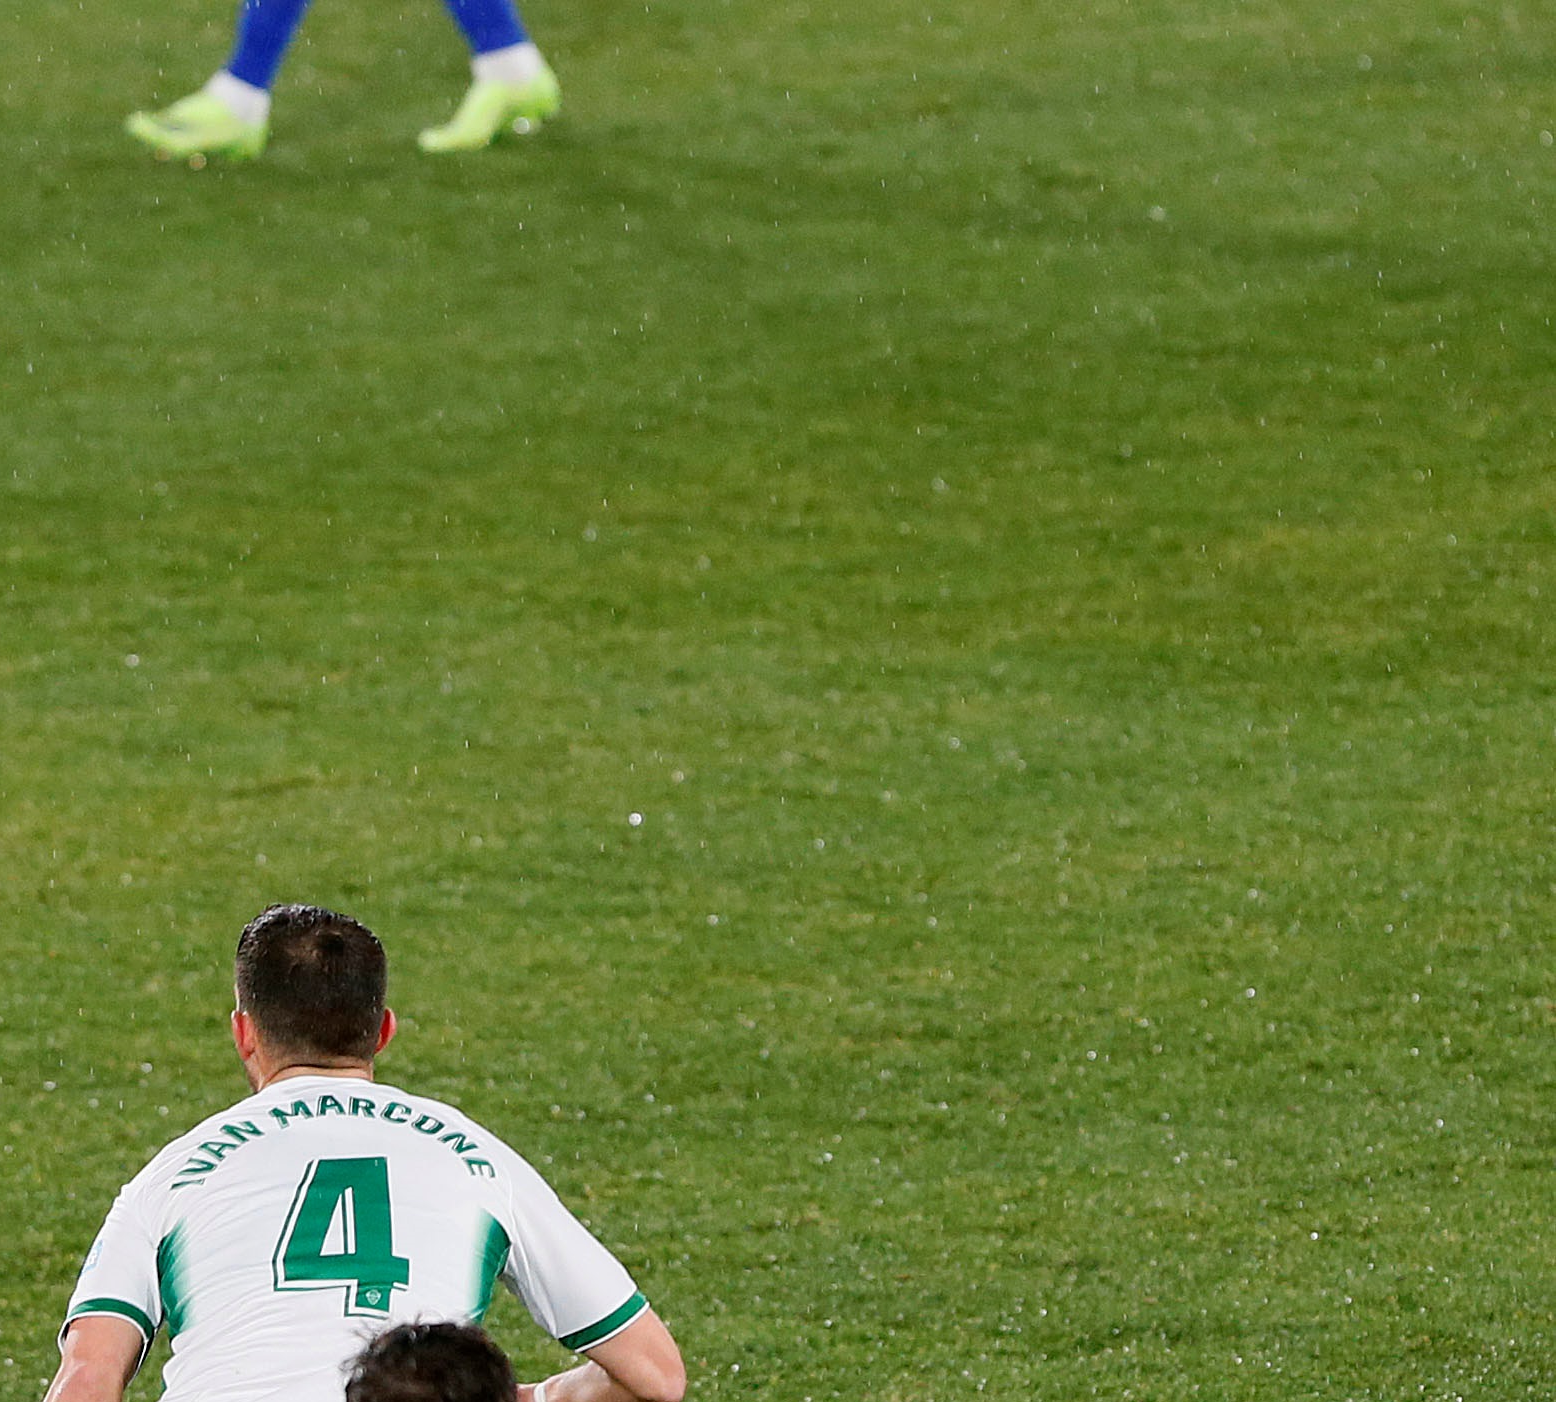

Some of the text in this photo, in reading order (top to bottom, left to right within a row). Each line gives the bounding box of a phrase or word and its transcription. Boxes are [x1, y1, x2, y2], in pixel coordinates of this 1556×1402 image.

[170, 1094, 496, 1191] IVAN MARCONE
[272, 1156, 410, 1318] 4
